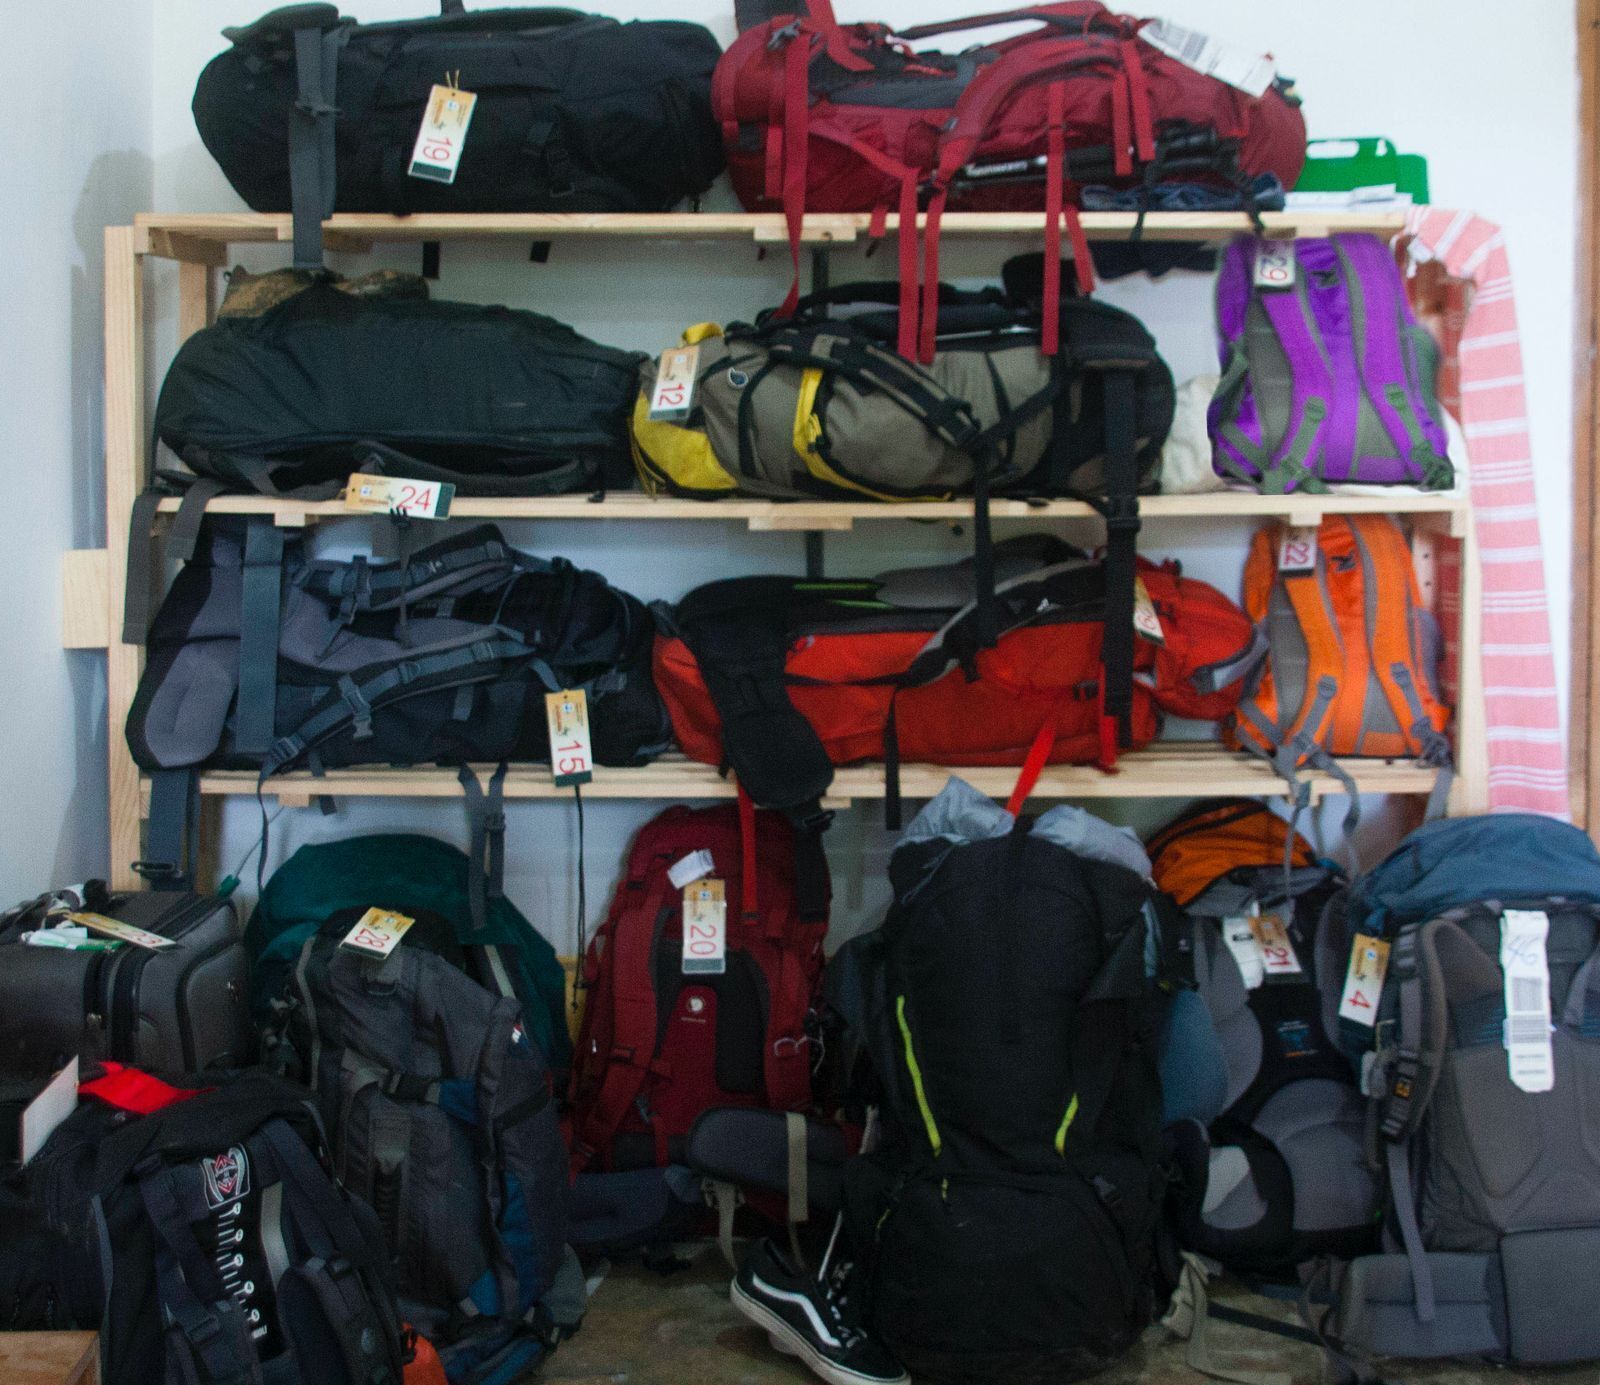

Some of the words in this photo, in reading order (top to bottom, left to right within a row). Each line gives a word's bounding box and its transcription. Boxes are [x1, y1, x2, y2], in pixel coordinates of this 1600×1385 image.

[422, 137, 454, 163] 19
[658, 383, 686, 408] 12
[397, 485, 431, 511] 24
[1282, 542, 1310, 567] 22
[559, 740, 586, 776] 15
[354, 926, 390, 949] 28
[690, 925, 717, 956] 20
[1264, 946, 1291, 968] 21
[1348, 990, 1371, 1010] 4
